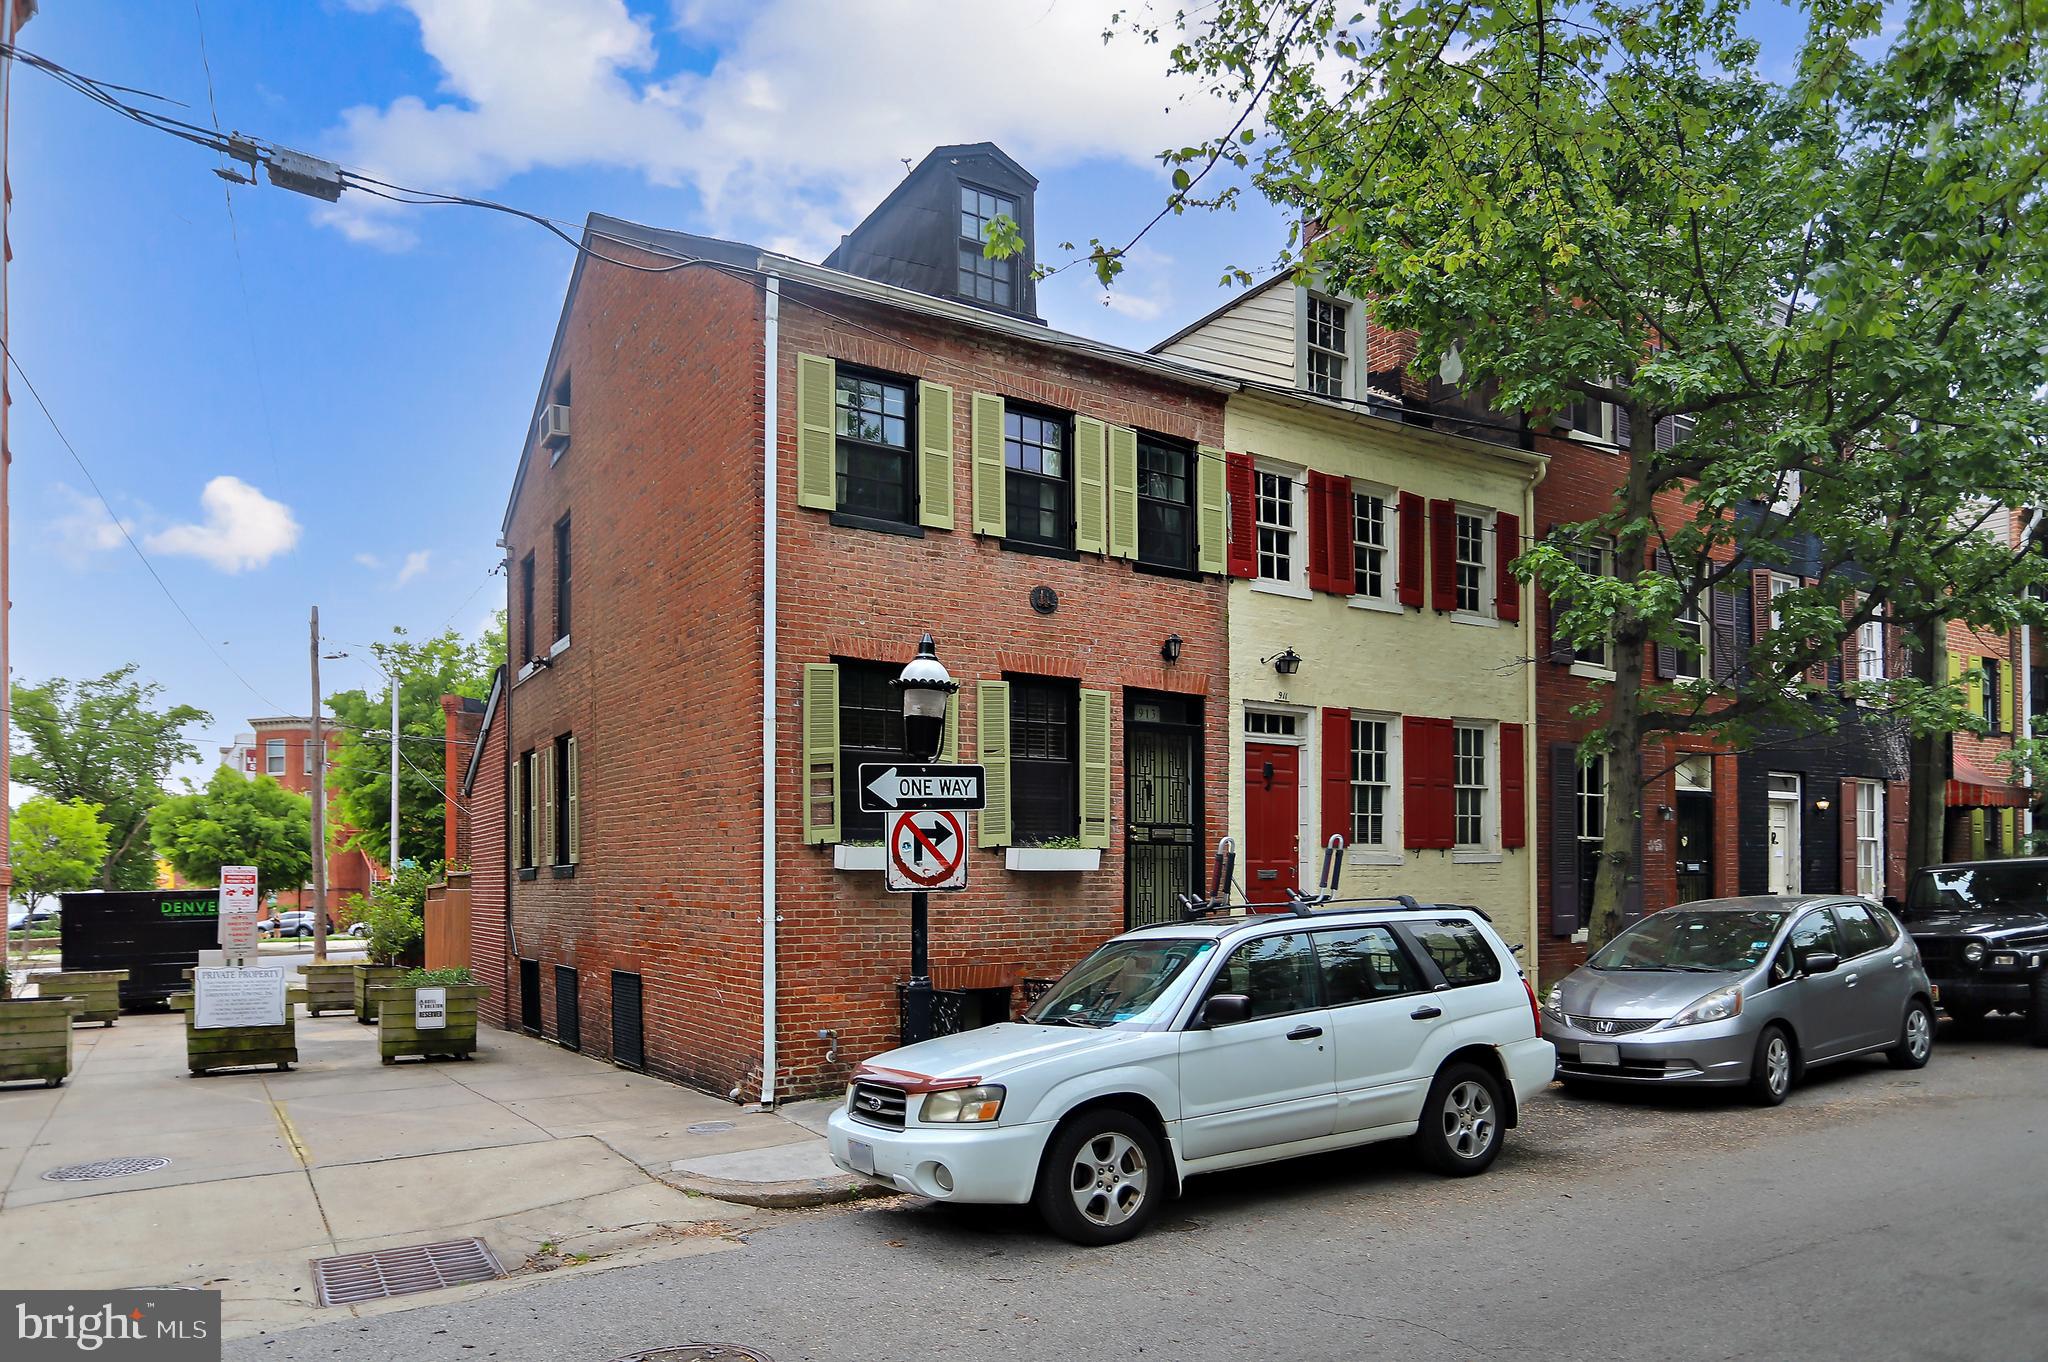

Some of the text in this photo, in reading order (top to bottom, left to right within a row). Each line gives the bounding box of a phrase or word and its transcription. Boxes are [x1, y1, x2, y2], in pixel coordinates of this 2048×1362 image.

[1278, 691, 1288, 700] 911
[1138, 707, 1156, 719] 913
[900, 779, 972, 796] ONE WAY
[161, 902, 219, 912] DENVE
[202, 970, 279, 979] PRIVATE PROPERTY
